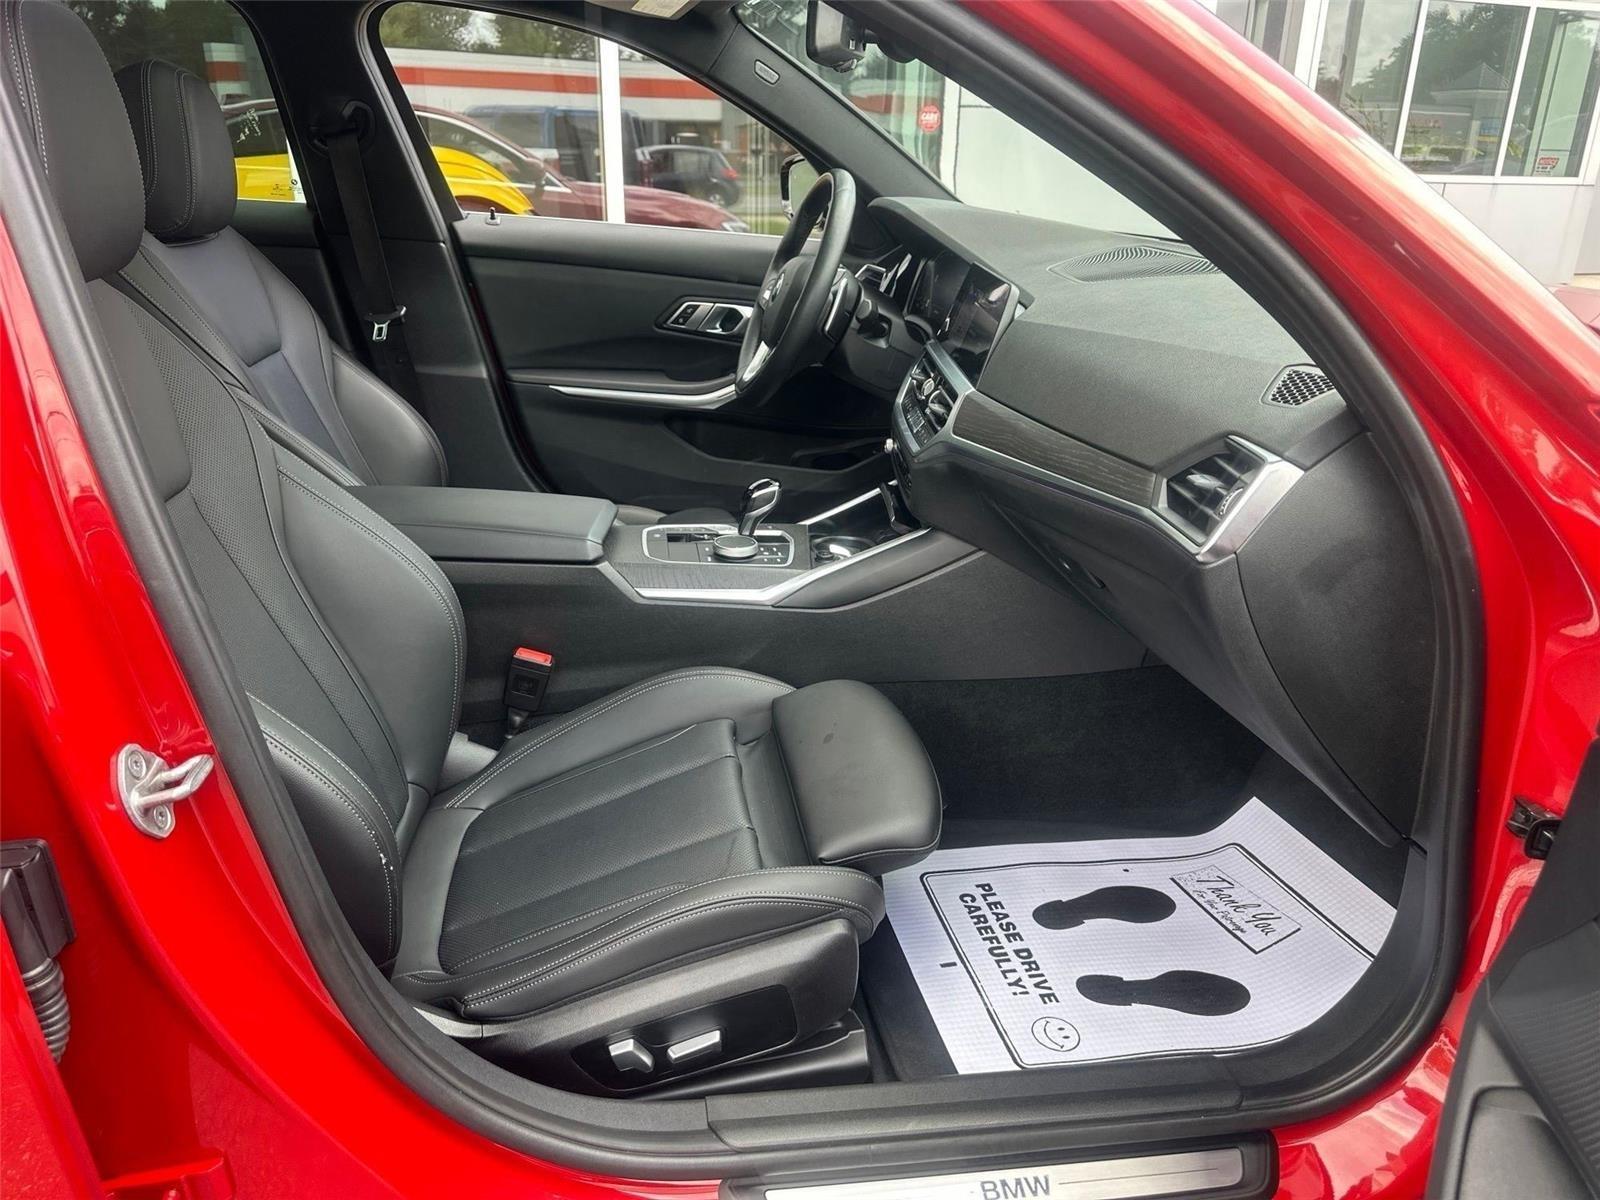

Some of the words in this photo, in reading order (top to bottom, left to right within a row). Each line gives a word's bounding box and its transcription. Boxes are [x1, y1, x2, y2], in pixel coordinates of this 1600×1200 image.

[959, 893, 1030, 996] CAREFULLY!
[975, 883, 1024, 943] PLEASE
[1013, 947, 1060, 1004] DRIVE
[1196, 875, 1261, 913] Thank
[1245, 912, 1281, 936] You
[980, 1175, 1050, 1200] BMW
